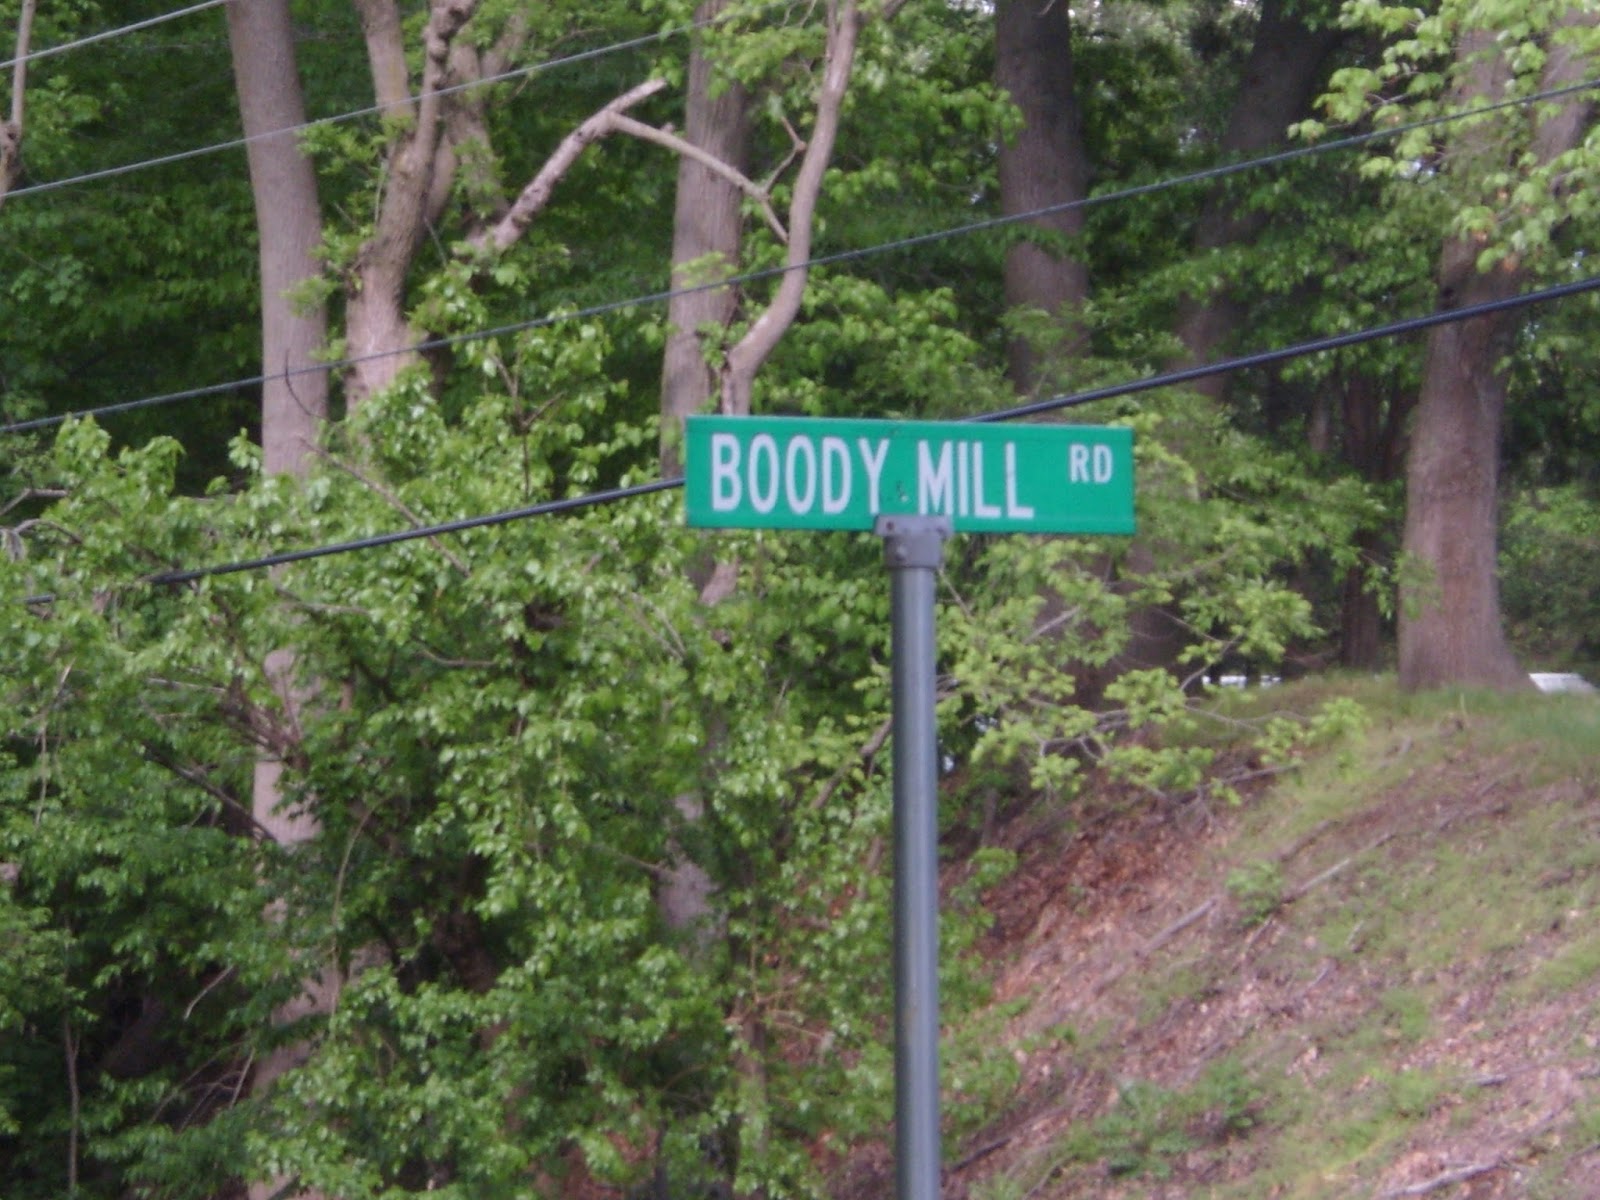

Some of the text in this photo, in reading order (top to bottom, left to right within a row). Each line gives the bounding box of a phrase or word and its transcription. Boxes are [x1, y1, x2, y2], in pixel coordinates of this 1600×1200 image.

[711, 433, 1112, 519] BOODY MILL RD
